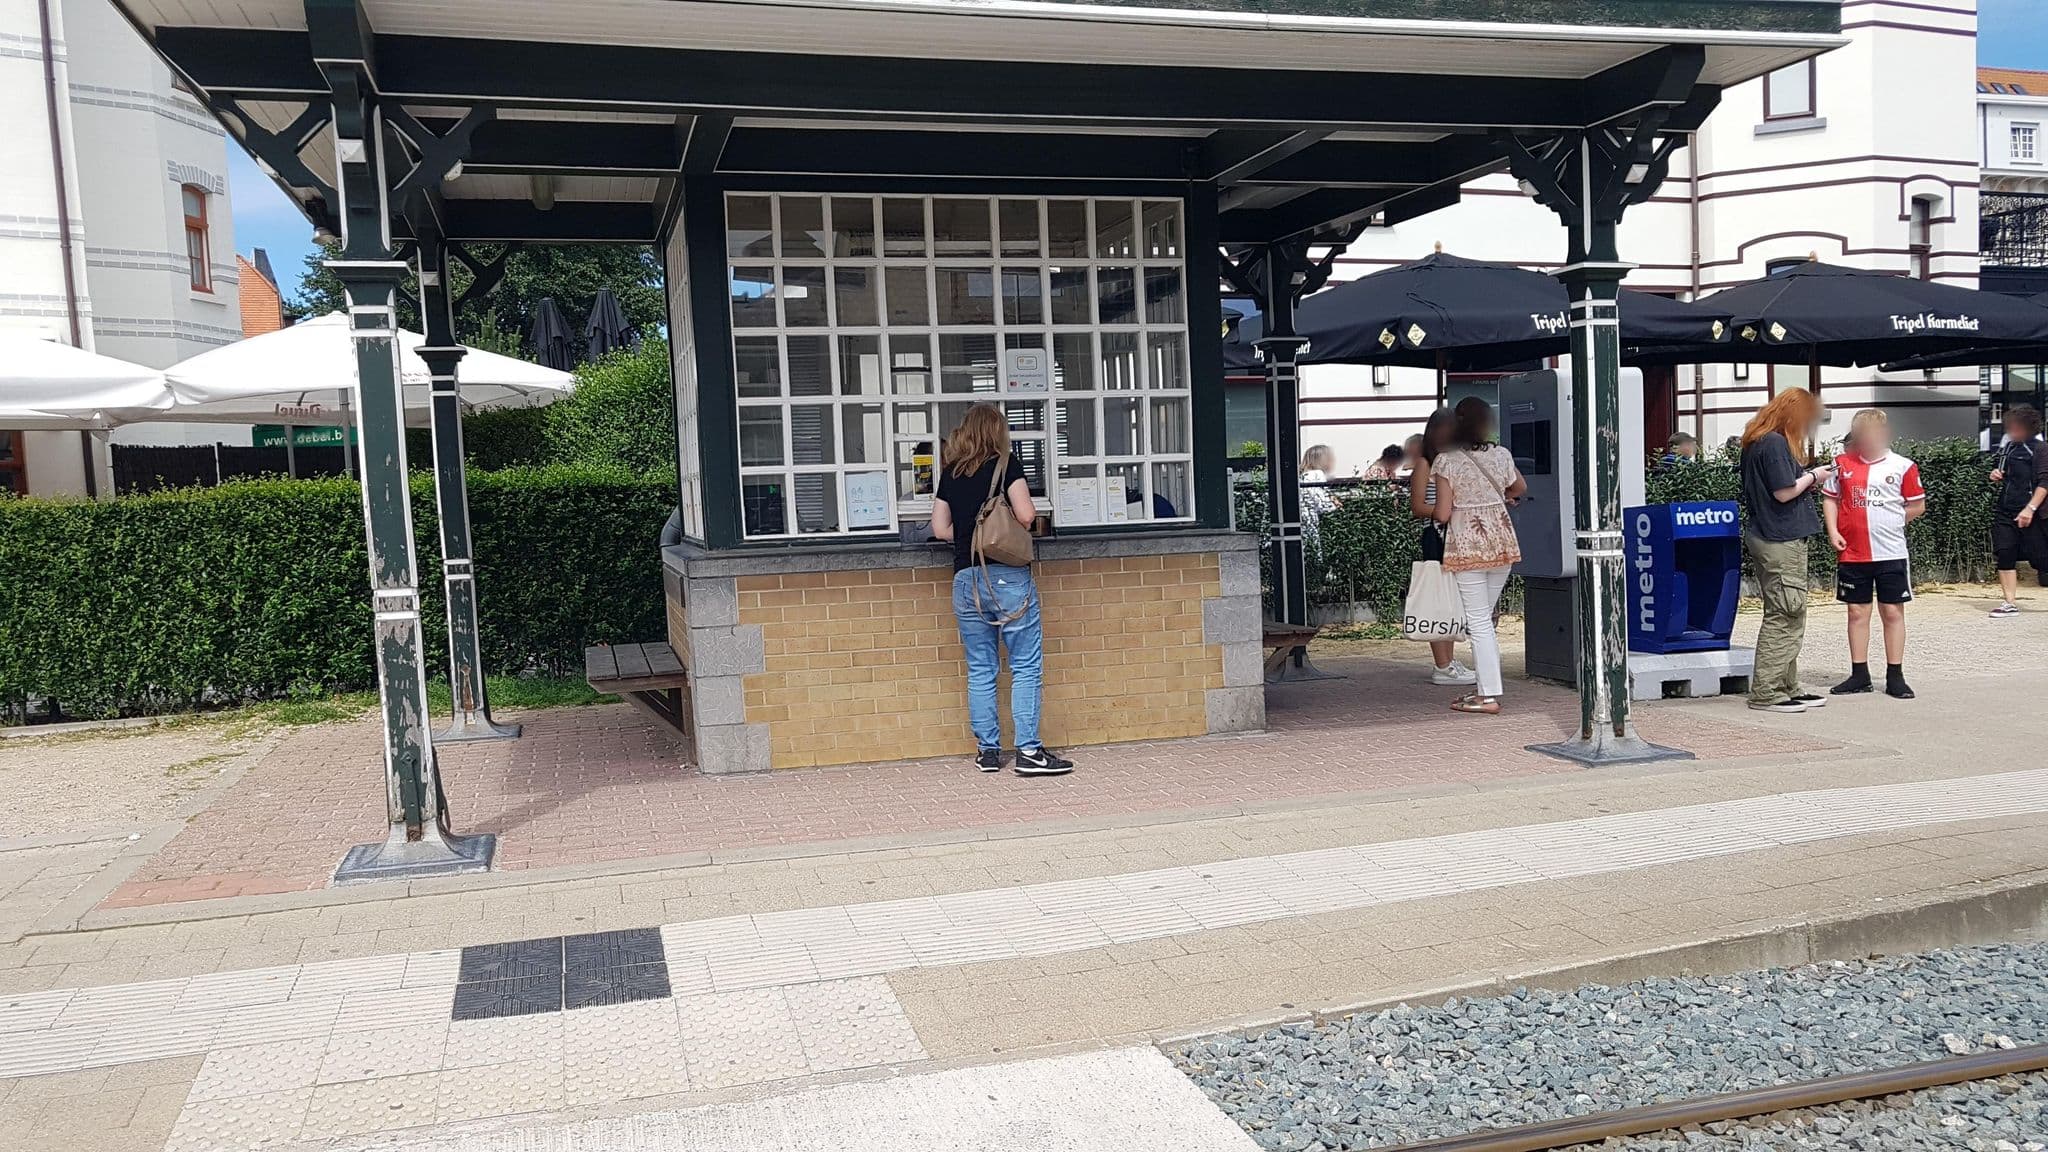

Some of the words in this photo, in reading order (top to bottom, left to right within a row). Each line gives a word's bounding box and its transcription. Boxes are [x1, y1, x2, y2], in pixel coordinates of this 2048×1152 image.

[1530, 311, 1567, 334] Tripel
[1889, 313, 1926, 334] Tripel
[1926, 313, 1980, 331] Karmeliet
[1852, 497, 1885, 508] Parcs
[1675, 506, 1735, 526] metro
[1634, 512, 1655, 632] metro
